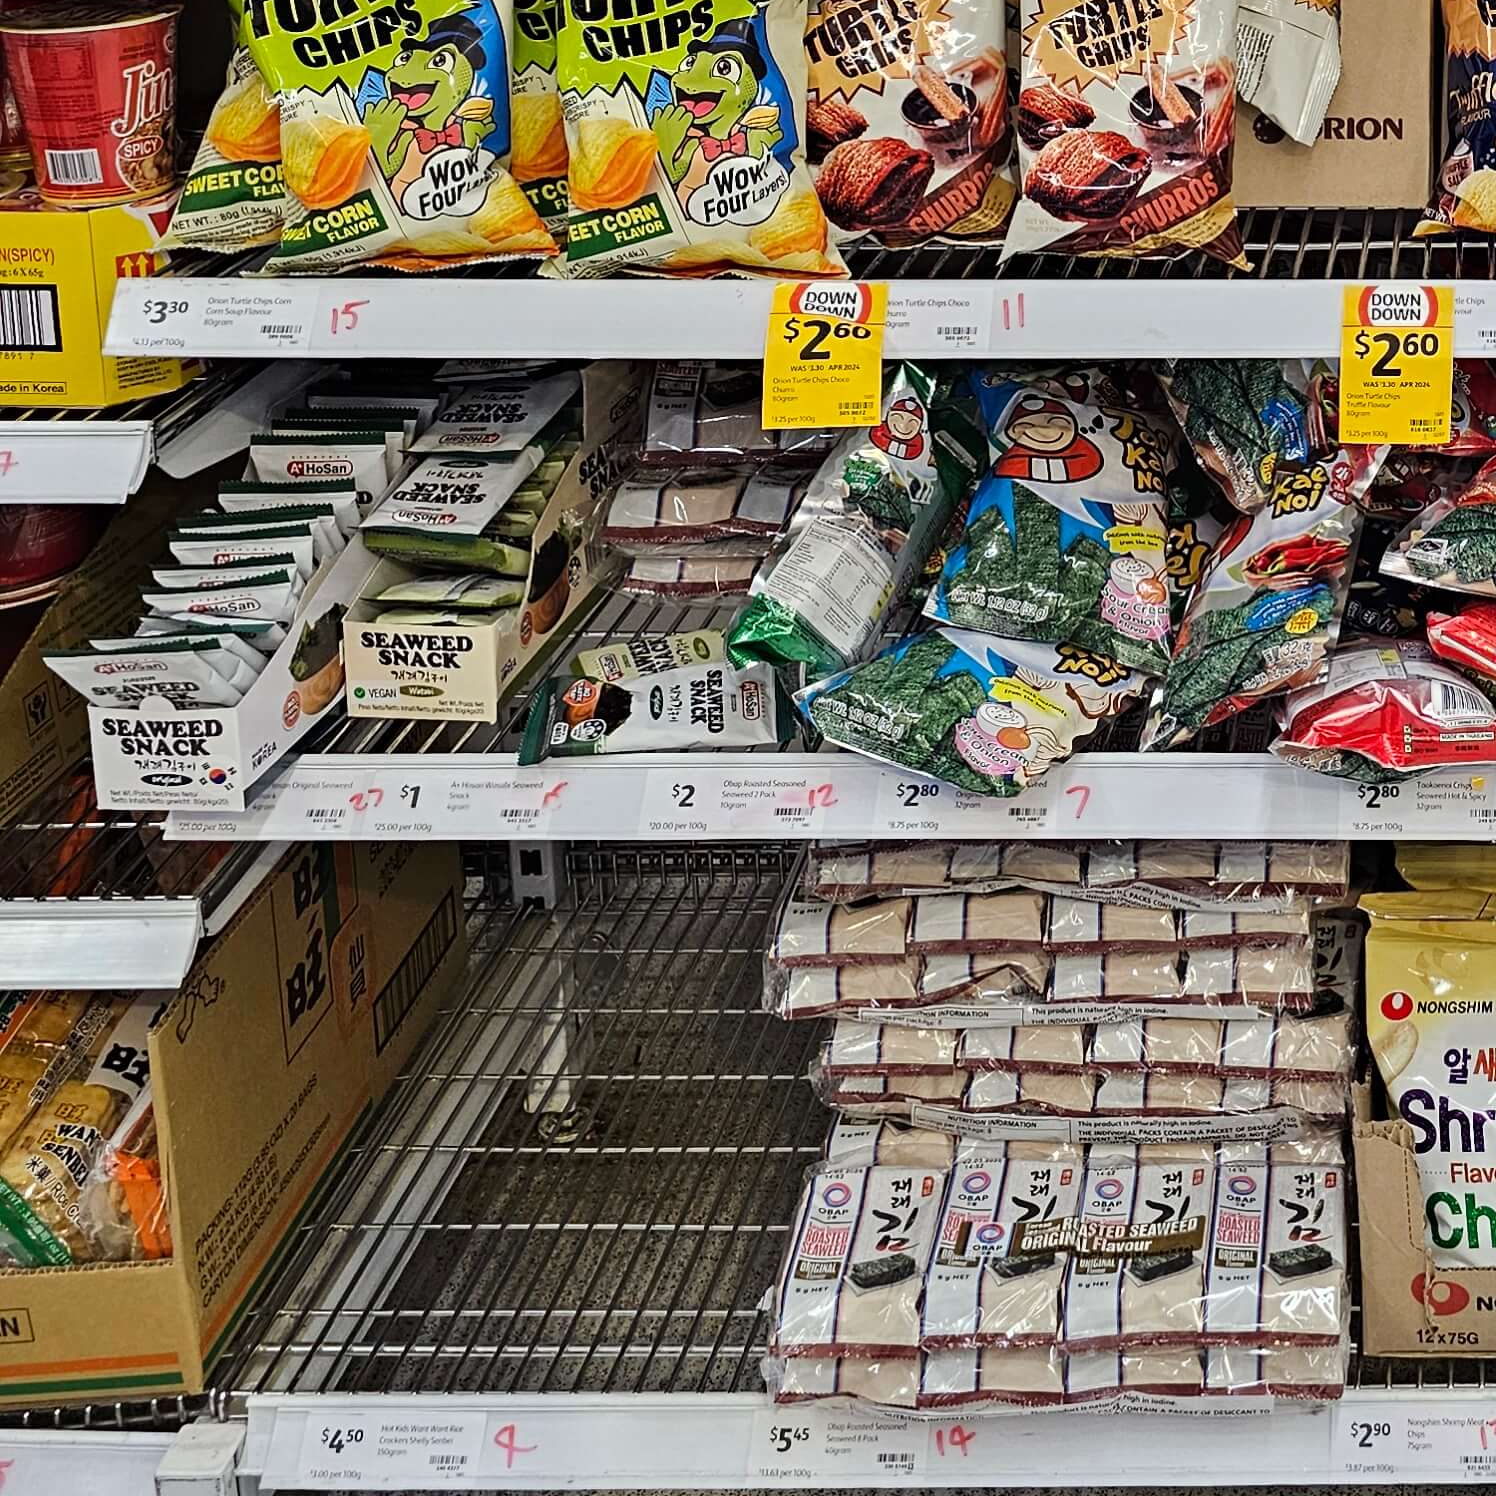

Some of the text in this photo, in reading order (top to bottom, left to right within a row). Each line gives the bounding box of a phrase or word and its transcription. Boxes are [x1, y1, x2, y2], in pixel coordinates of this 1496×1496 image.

[121, 137, 161, 159] SPICY
[1120, 169, 1219, 234] CHURROS
[1372, 294, 1421, 307] DOWN
[328, 299, 370, 336] 15
[1372, 308, 1421, 320] DOWN
[304, 462, 349, 476] HoSan
[369, 688, 397, 698] VEGAN
[103, 718, 223, 737] SEAWEED
[121, 738, 210, 755] SNACK
[672, 784, 695, 807] $2
[808, 783, 838, 808] 12
[1416, 1000, 1493, 1015] NONGSHIM
[1129, 1216, 1198, 1237] SEAWEED
